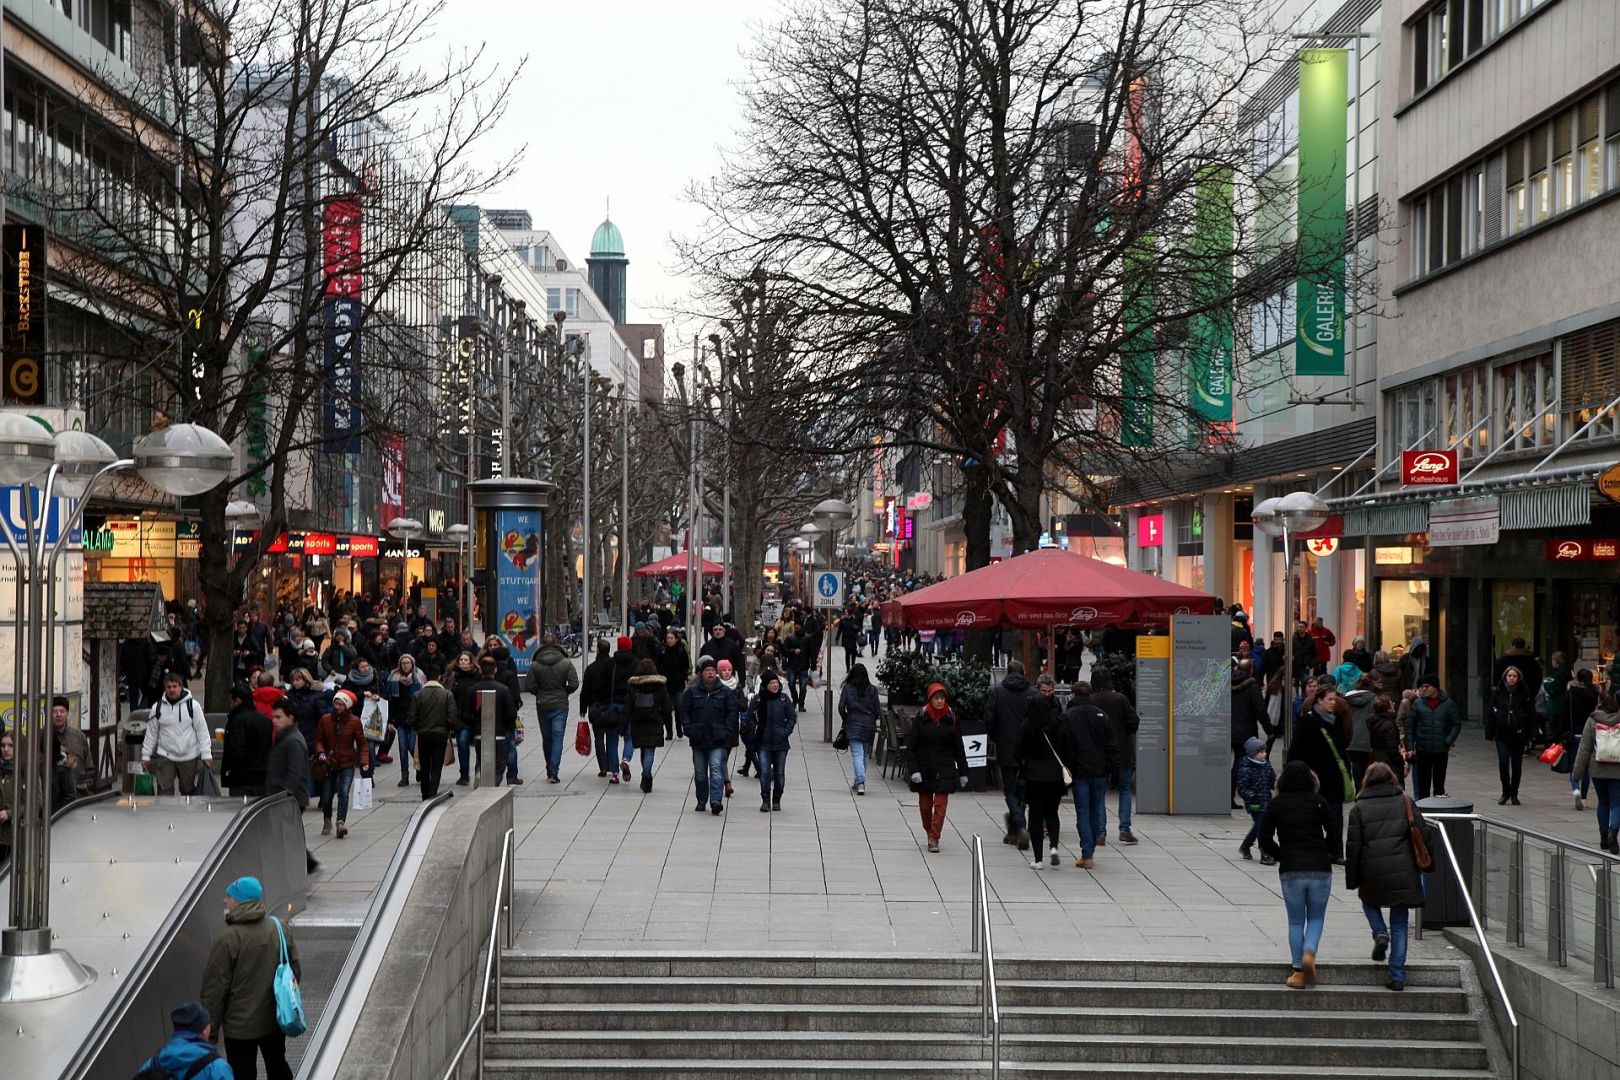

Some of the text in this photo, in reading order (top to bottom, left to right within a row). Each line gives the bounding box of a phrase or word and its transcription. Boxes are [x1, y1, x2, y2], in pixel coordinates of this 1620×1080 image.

[1316, 280, 1334, 341] GALERIA
[1410, 453, 1450, 474] Lang
[429, 508, 445, 532] MANGO
[518, 515, 529, 524] WE
[306, 538, 330, 549] sports
[351, 541, 374, 552] sports
[1555, 541, 1582, 559] Lang
[500, 577, 539, 585] STUTTGAR
[517, 596, 529, 605] WE
[820, 598, 836, 606] ZONE
